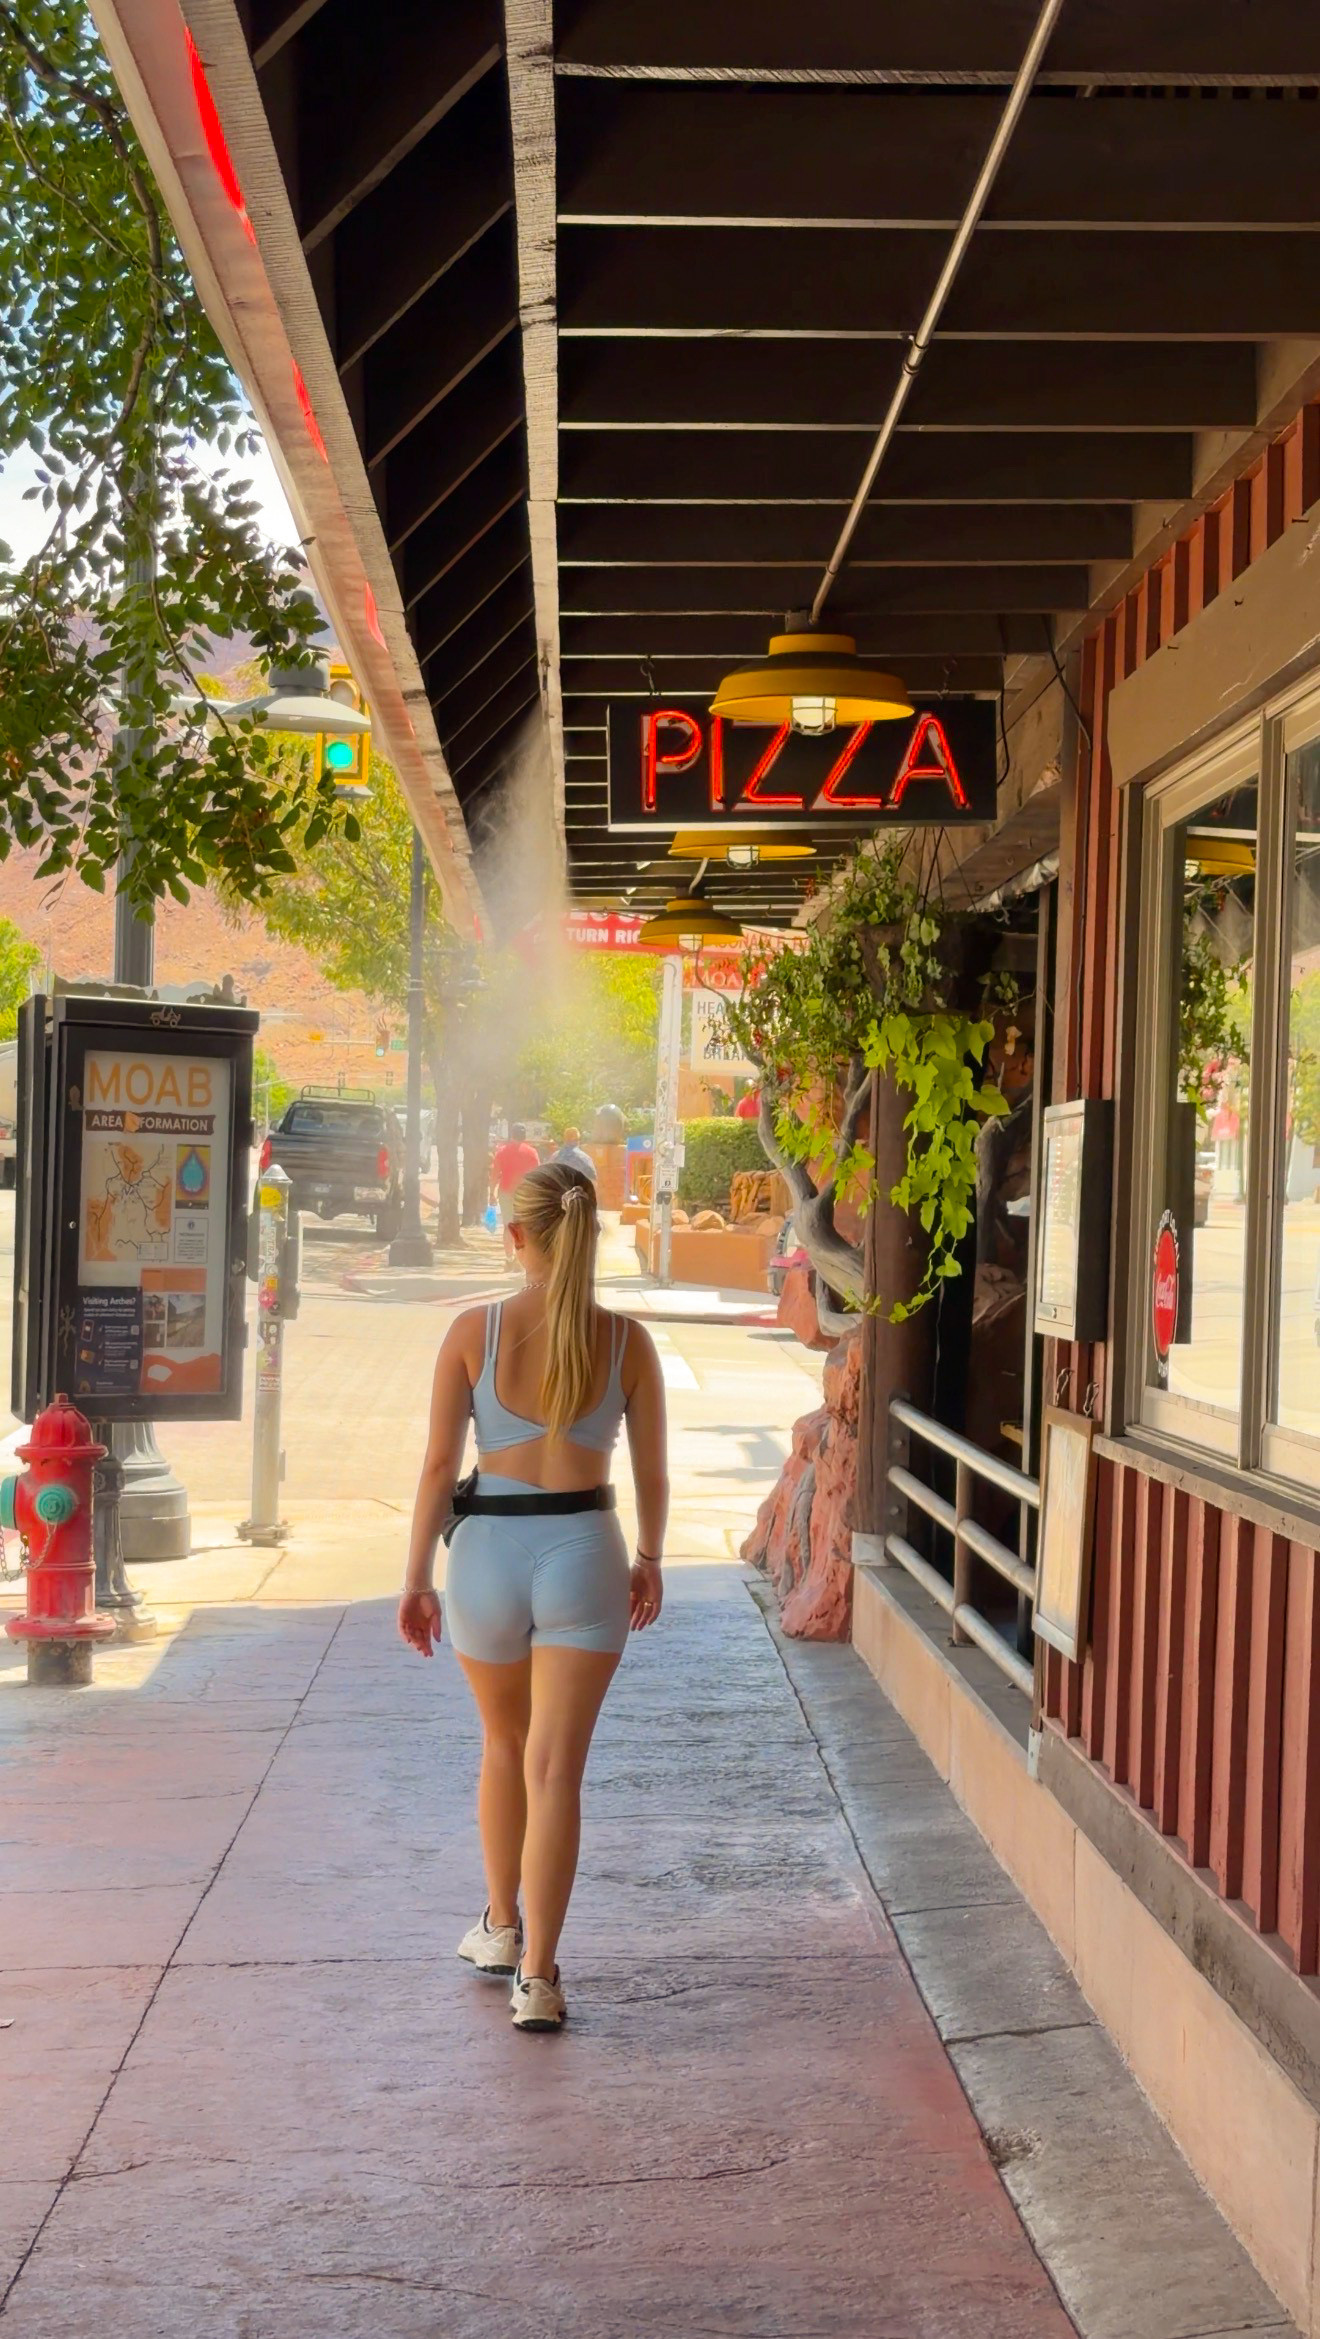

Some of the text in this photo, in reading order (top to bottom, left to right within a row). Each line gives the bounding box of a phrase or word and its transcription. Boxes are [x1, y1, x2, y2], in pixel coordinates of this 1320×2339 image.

[641, 710, 973, 813] PIZZA
[566, 927, 609, 943] TURN
[87, 1062, 213, 1108] MOAB
[91, 1114, 208, 1131] AREA FORMATION
